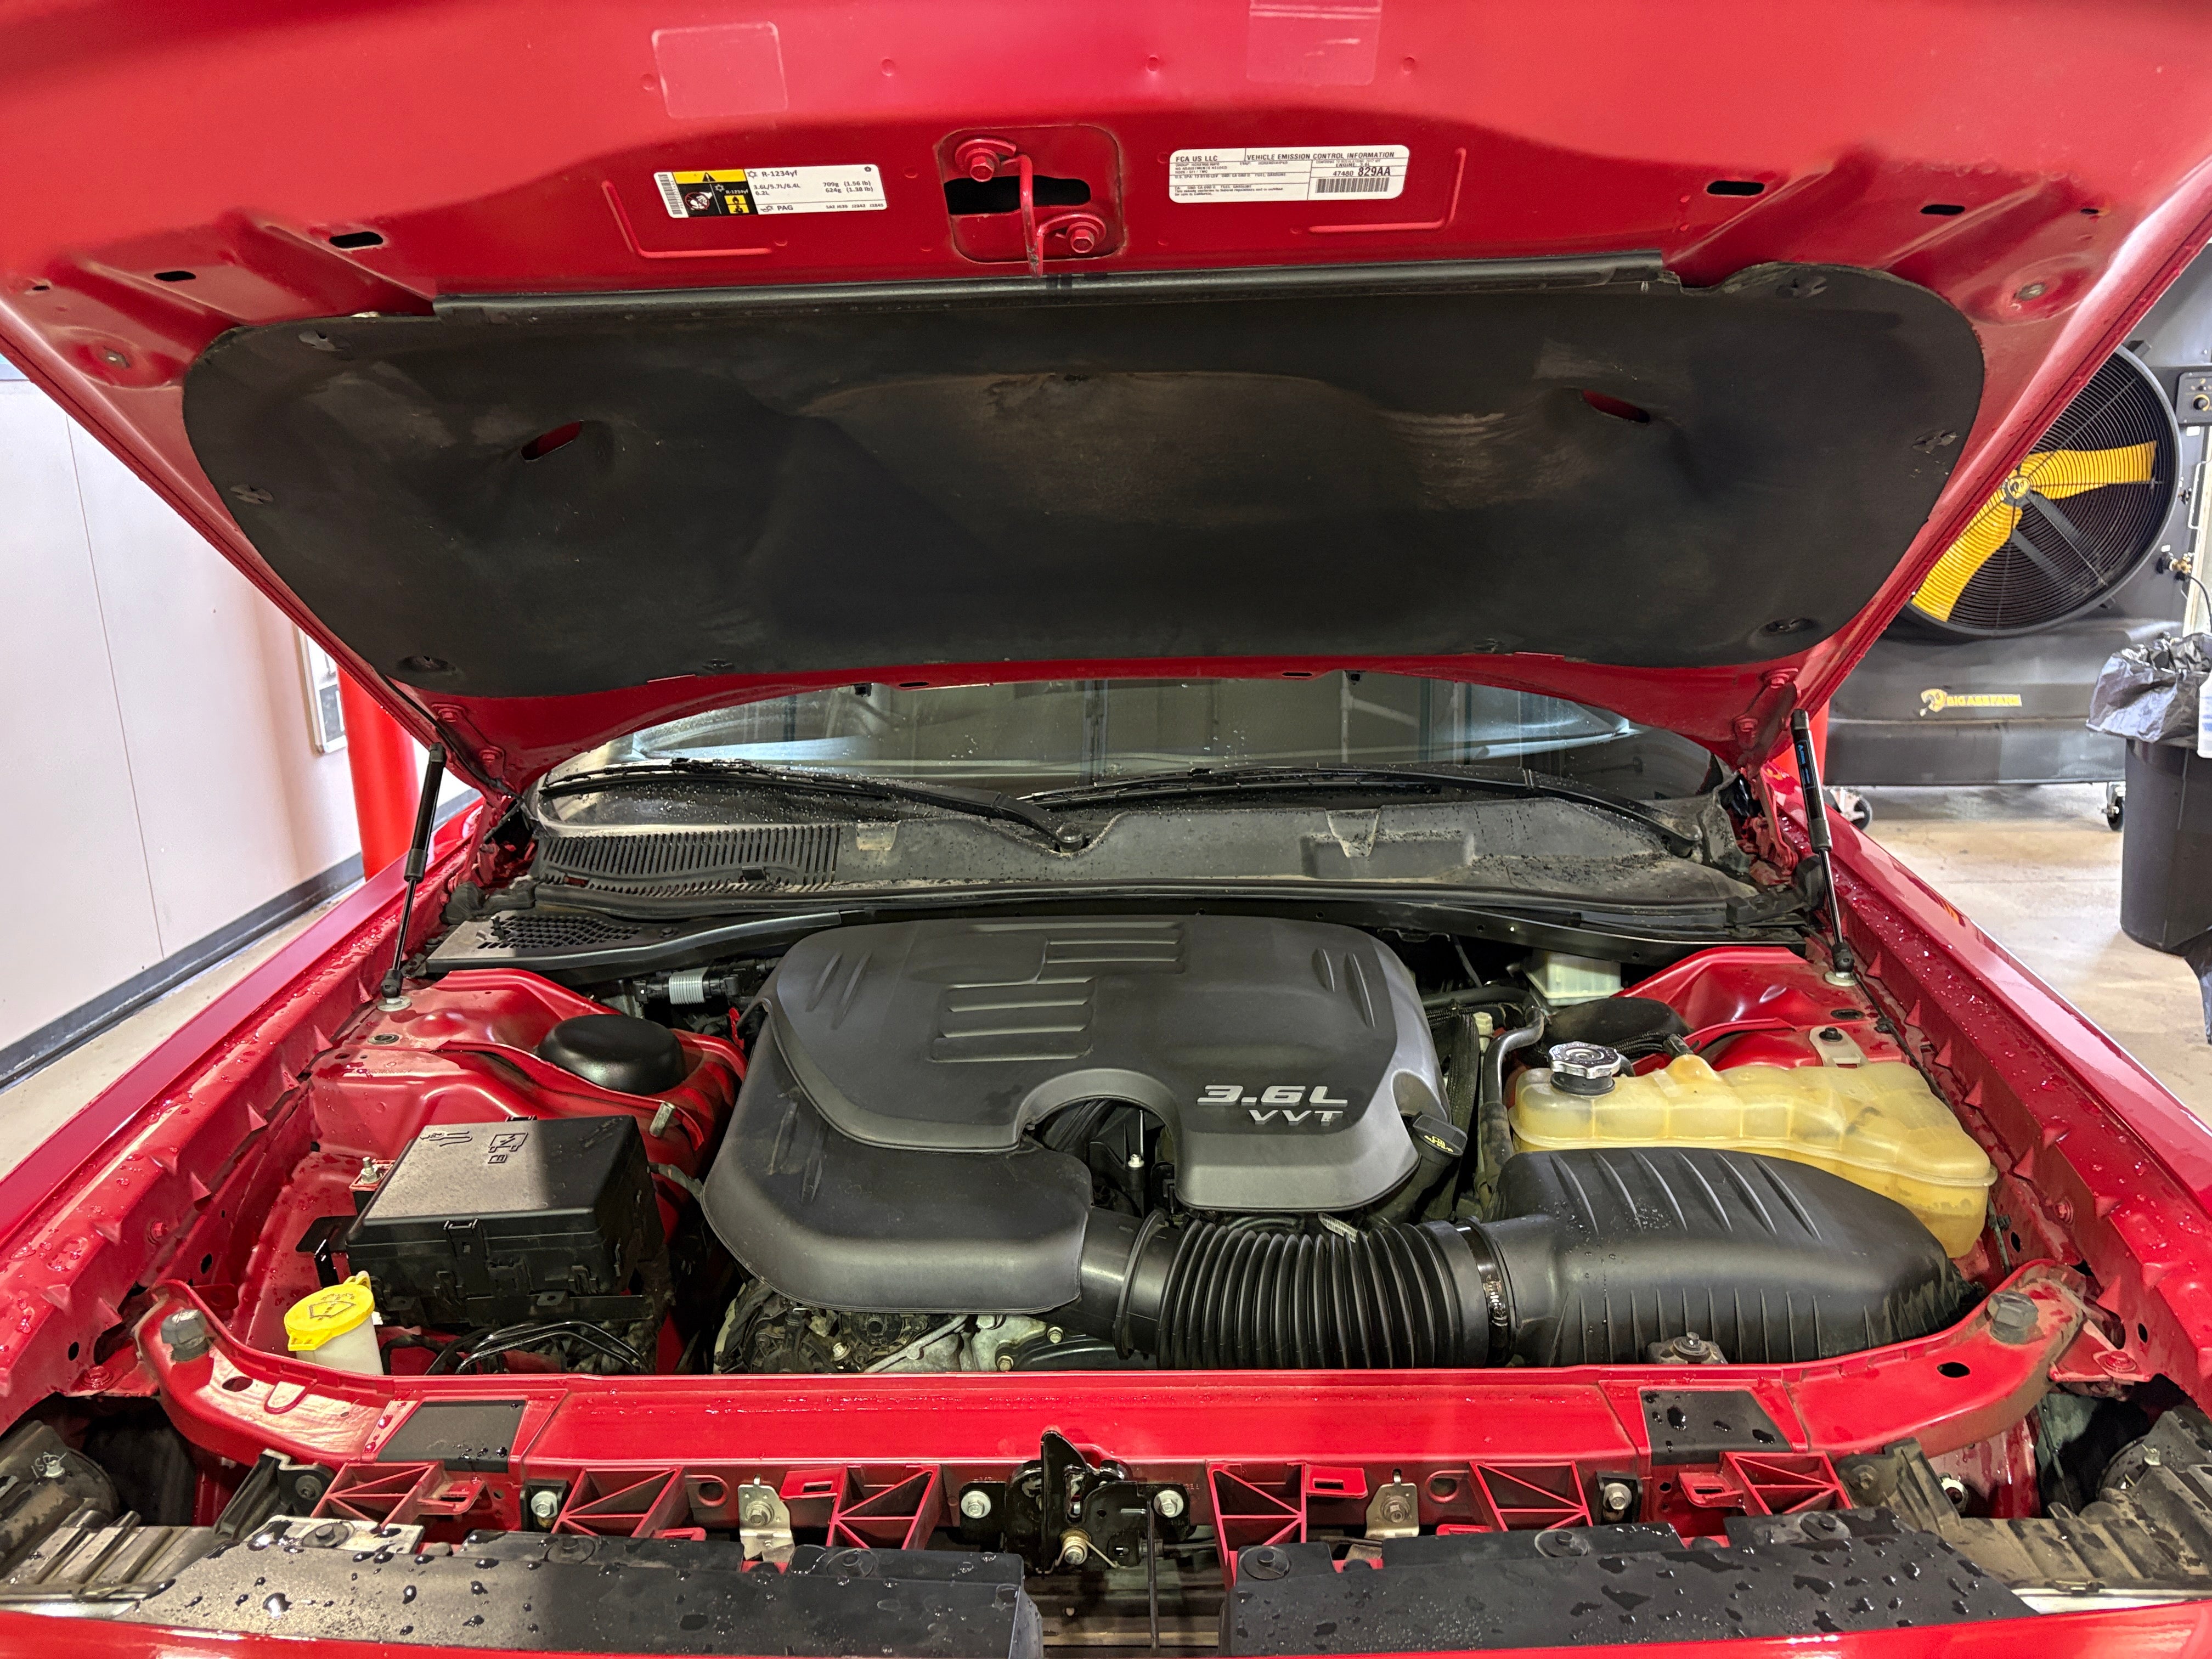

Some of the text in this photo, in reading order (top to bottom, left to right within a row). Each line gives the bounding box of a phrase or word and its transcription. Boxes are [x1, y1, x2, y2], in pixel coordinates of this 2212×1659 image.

[1358, 166, 1391, 176] 829AA
[1197, 1085, 1348, 1105] 3.6L
[1249, 1110, 1344, 1125] VVT
